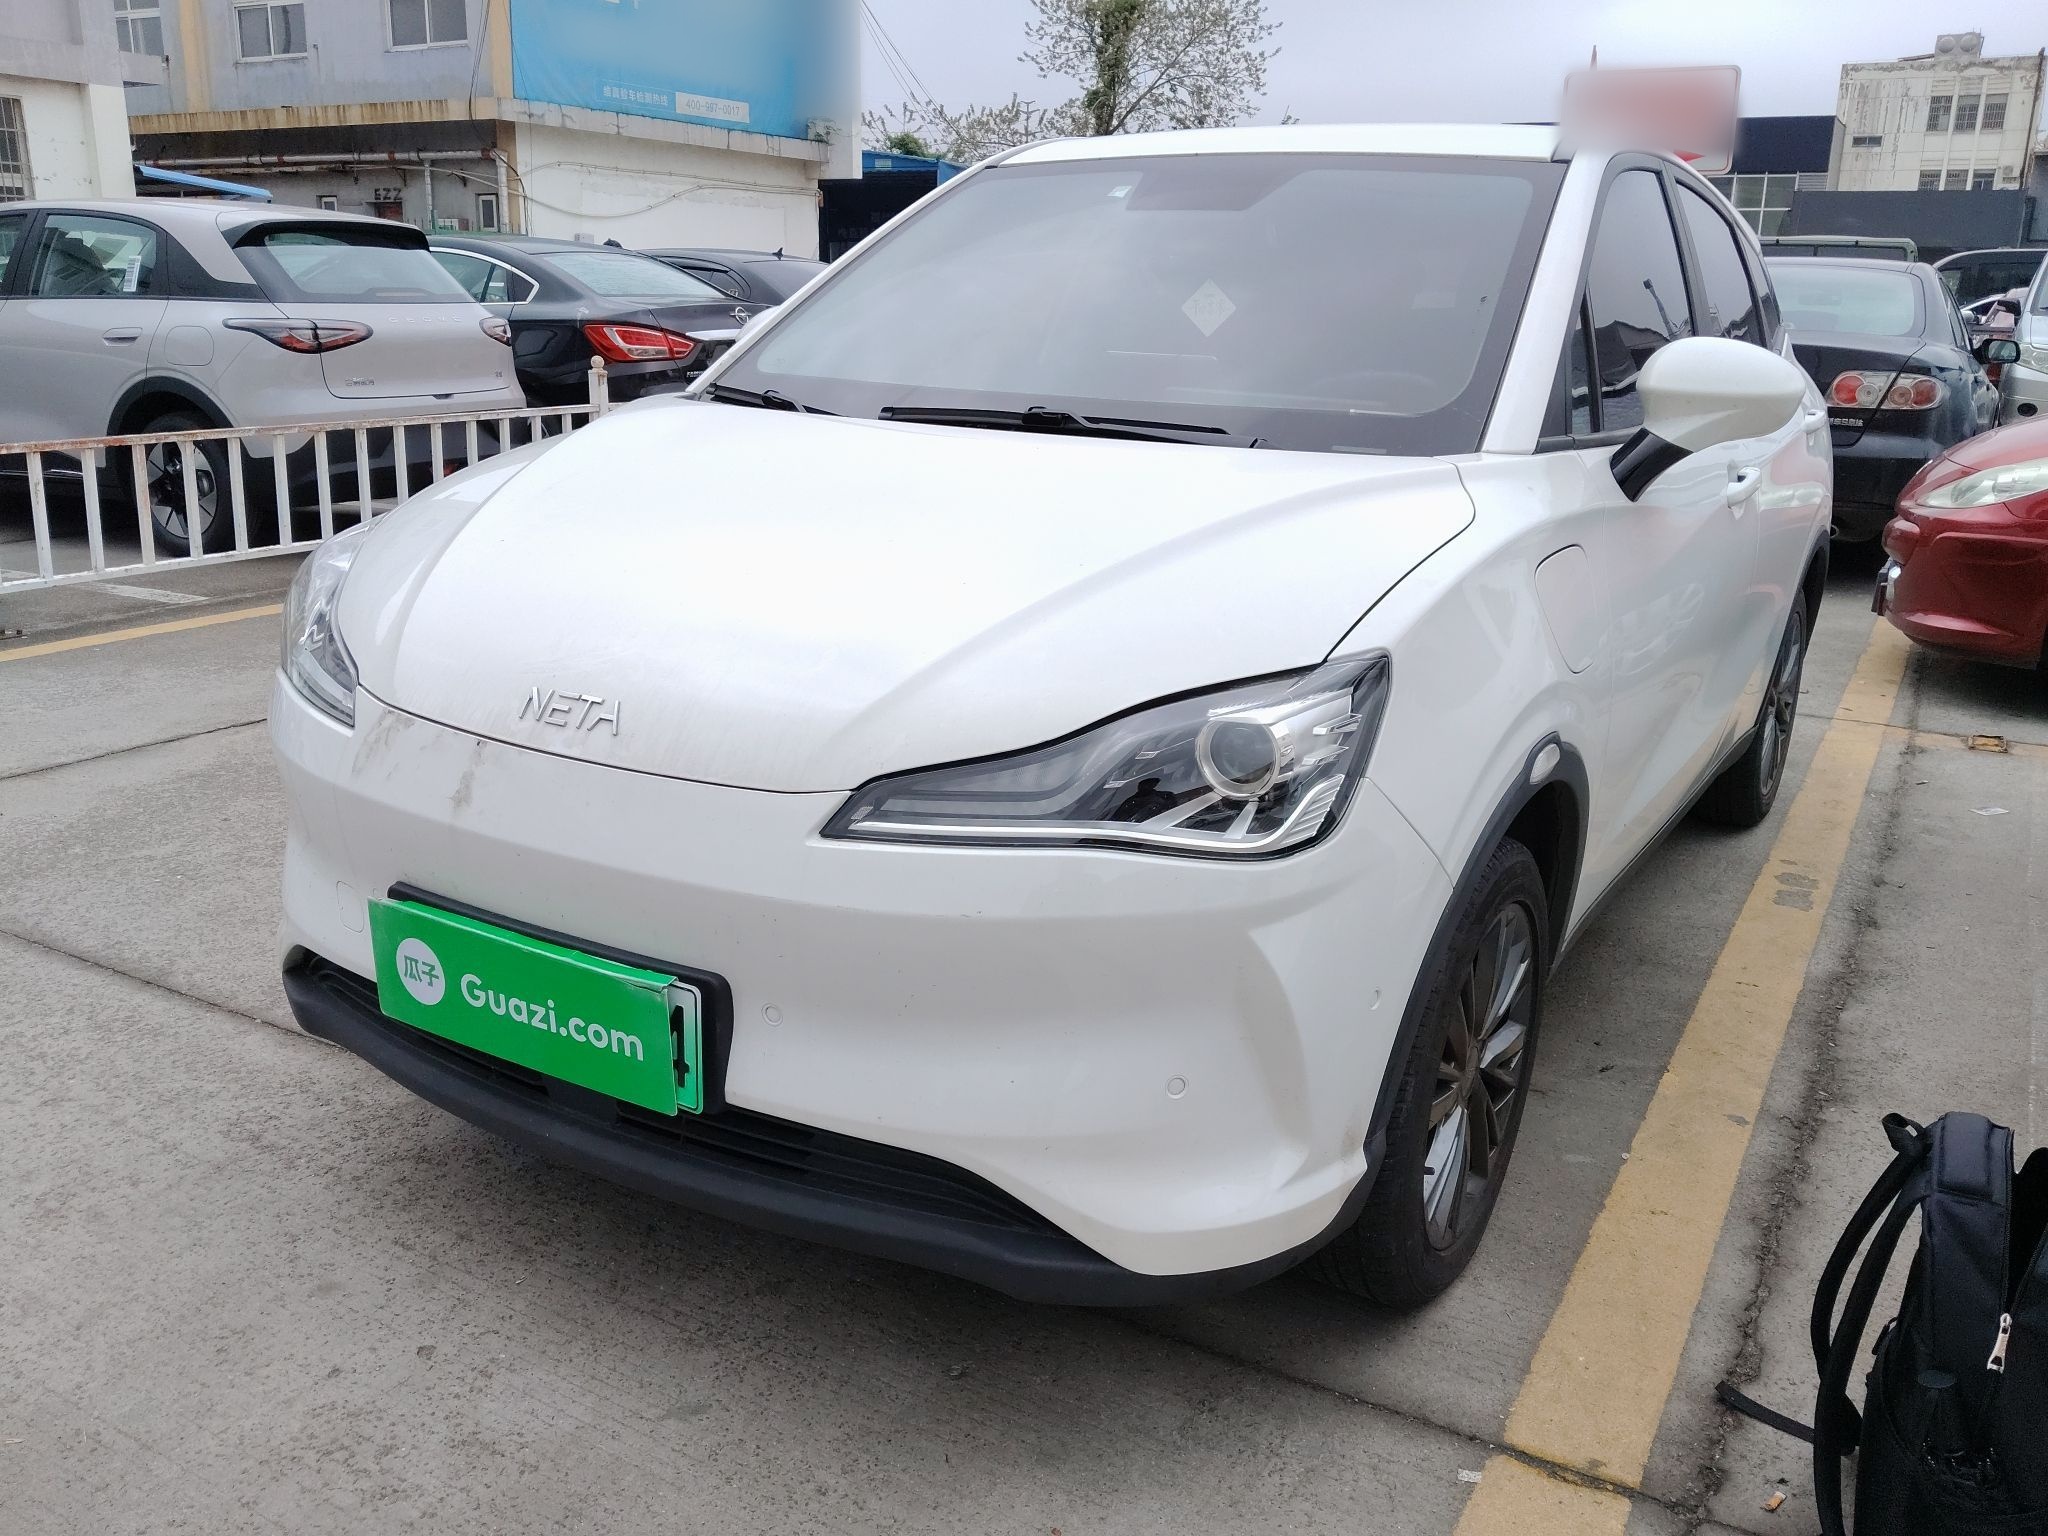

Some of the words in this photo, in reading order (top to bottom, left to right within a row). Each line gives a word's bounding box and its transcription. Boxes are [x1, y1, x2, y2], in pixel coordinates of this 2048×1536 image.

[519, 687, 620, 736] NETA
[404, 955, 440, 988] 瓜子
[460, 973, 644, 1061] Guazi.com
